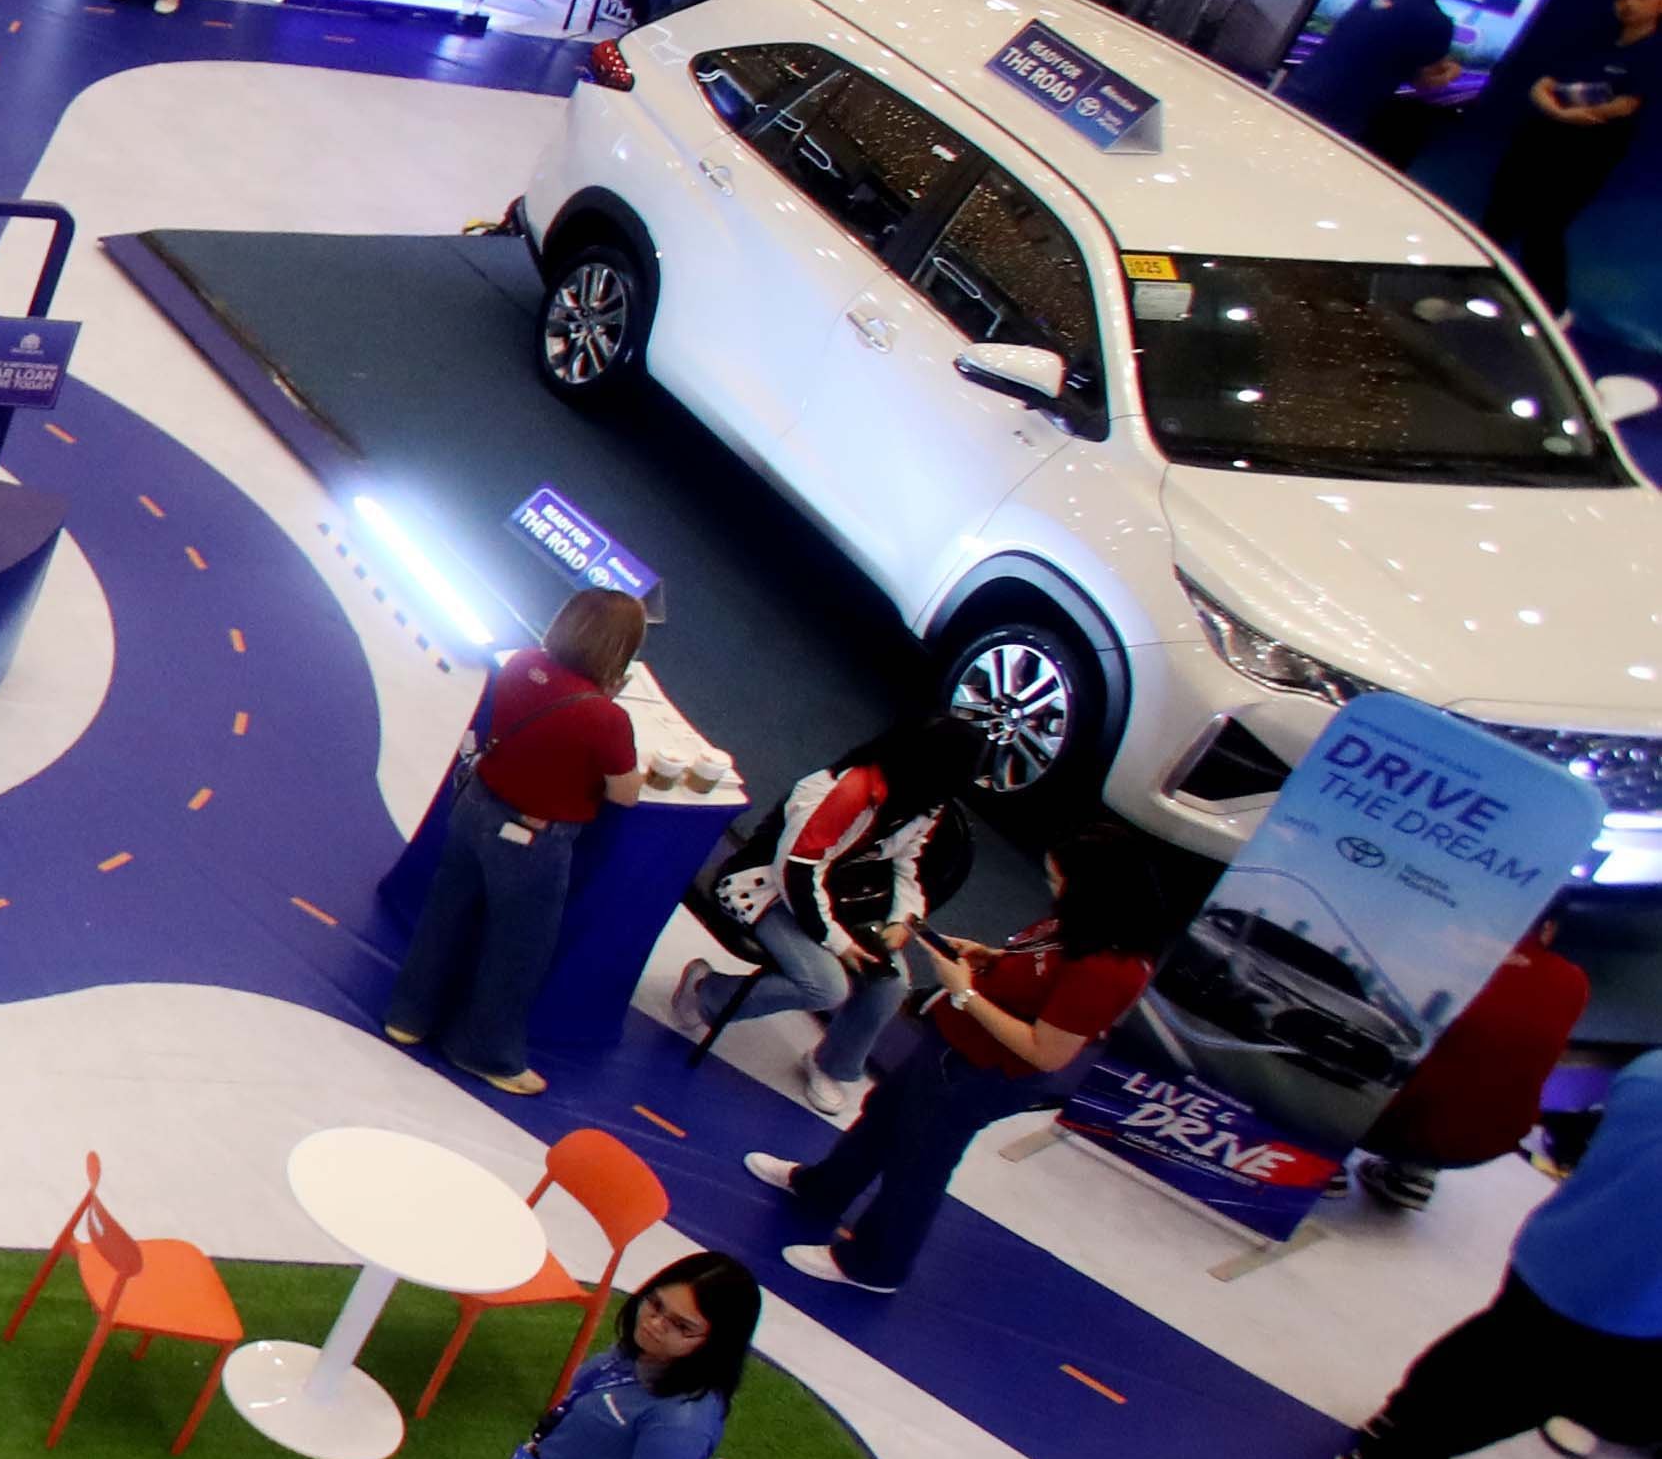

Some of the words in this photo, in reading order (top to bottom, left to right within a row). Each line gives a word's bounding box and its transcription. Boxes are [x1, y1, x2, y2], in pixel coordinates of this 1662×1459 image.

[1001, 45, 1037, 82] THE
[1034, 65, 1076, 103] ROAD
[1026, 40, 1062, 70] READY
[1059, 58, 1084, 80] FOR
[16, 369, 58, 381] LOAN
[519, 508, 553, 540] THE
[546, 530, 587, 571] ROAD
[1323, 734, 1509, 834] DRIVE
[1318, 772, 1395, 821] THE
[1392, 811, 1542, 888] DREAM
[1122, 1072, 1219, 1123] LIVE
[1118, 1102, 1297, 1179] DRIVE
